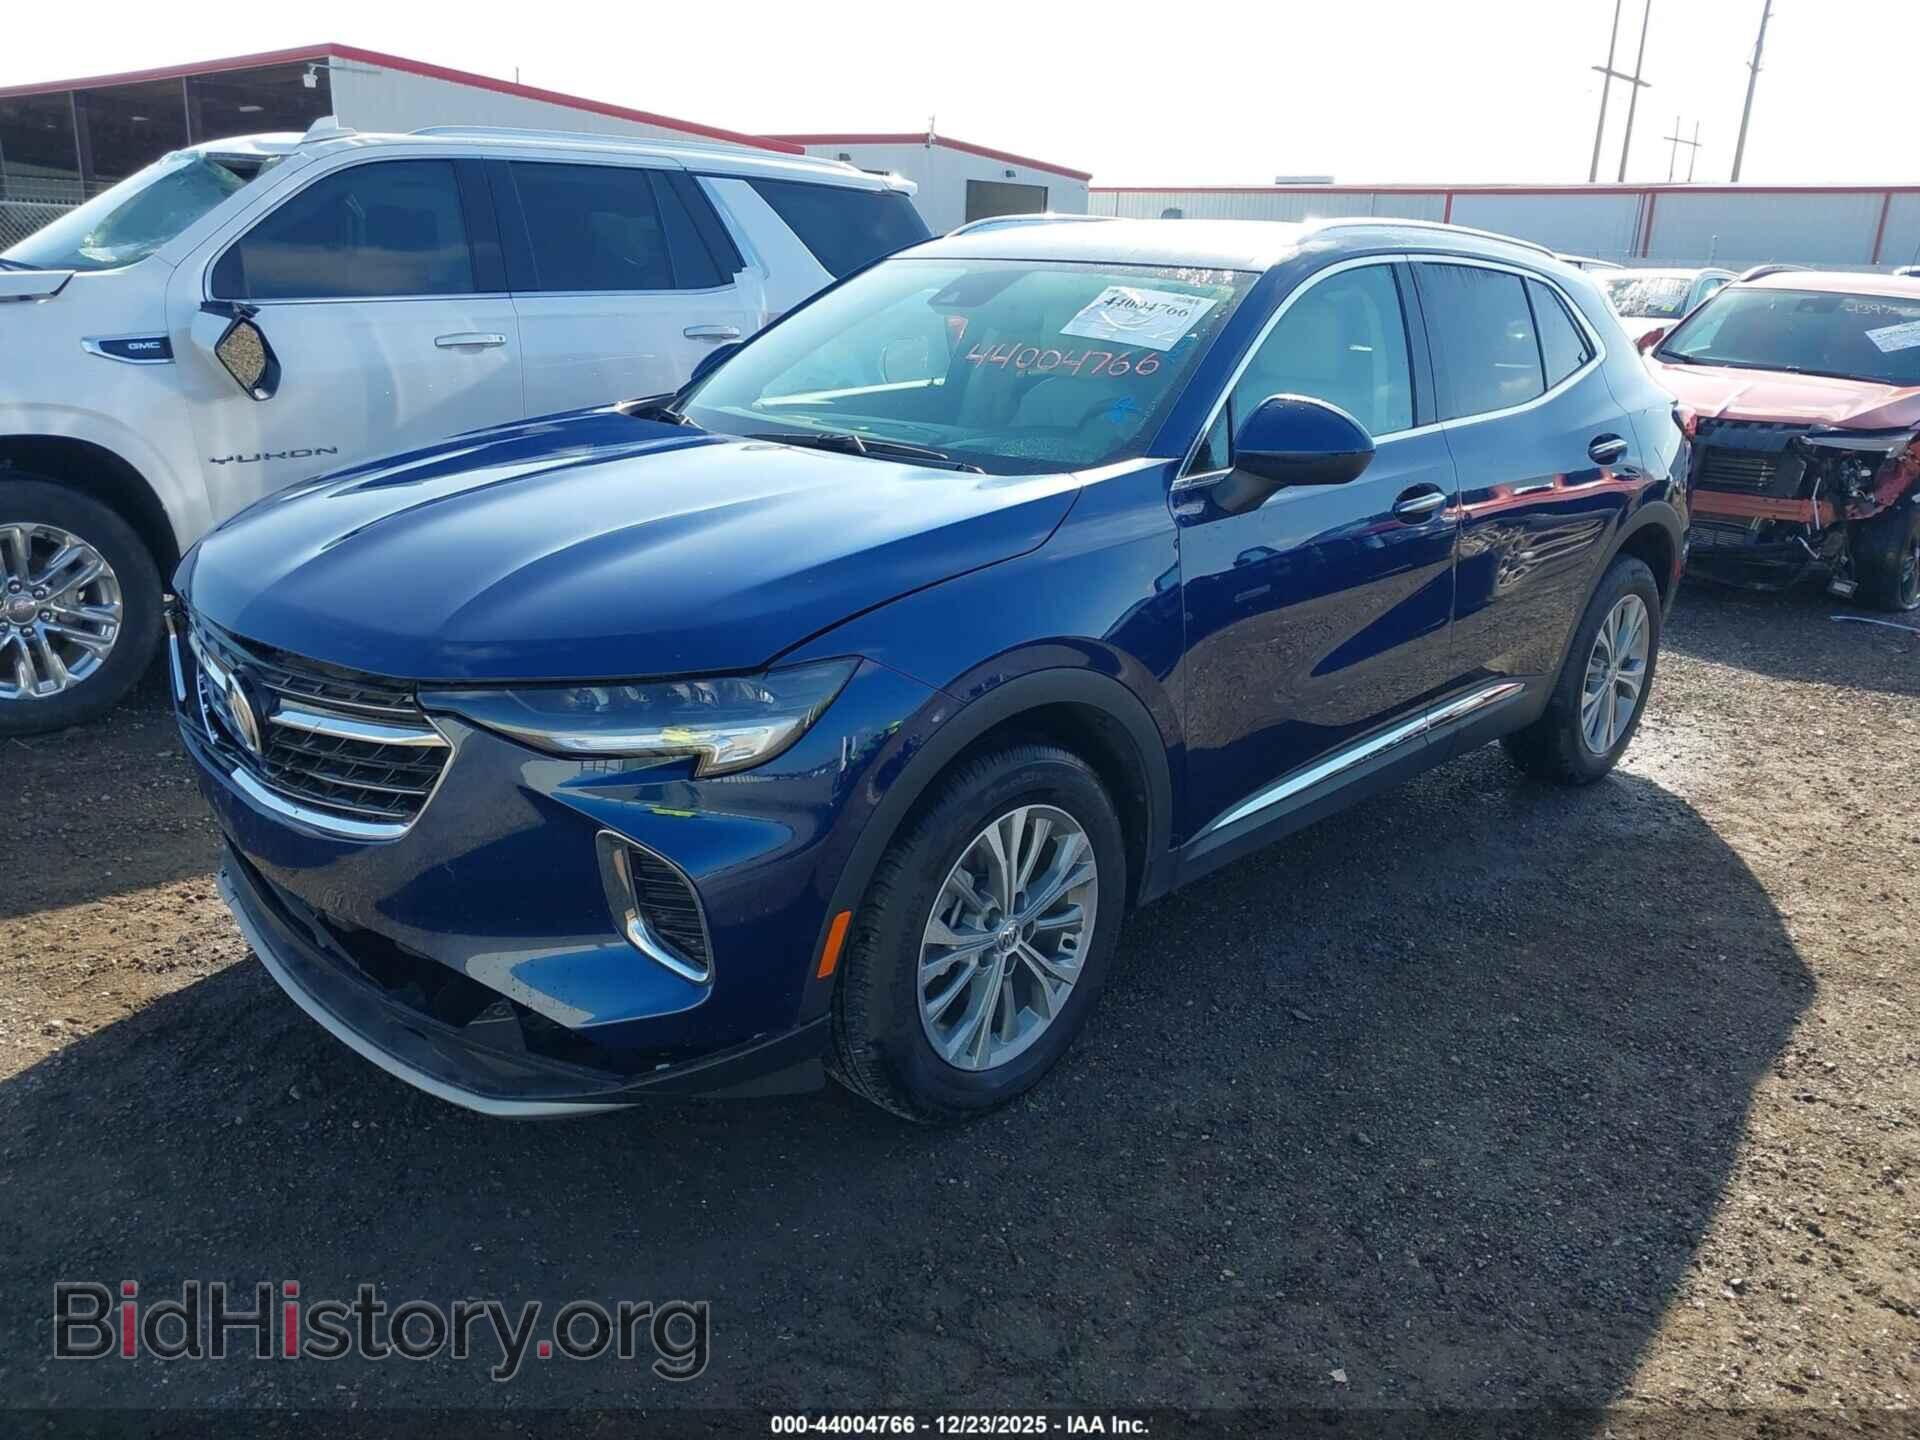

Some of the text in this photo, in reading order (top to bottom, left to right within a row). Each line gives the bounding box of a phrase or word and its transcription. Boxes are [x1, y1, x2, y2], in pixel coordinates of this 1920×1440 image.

[128, 341, 160, 350] GMC
[965, 342, 1160, 377] 44004766
[209, 446, 337, 464] YUKON
